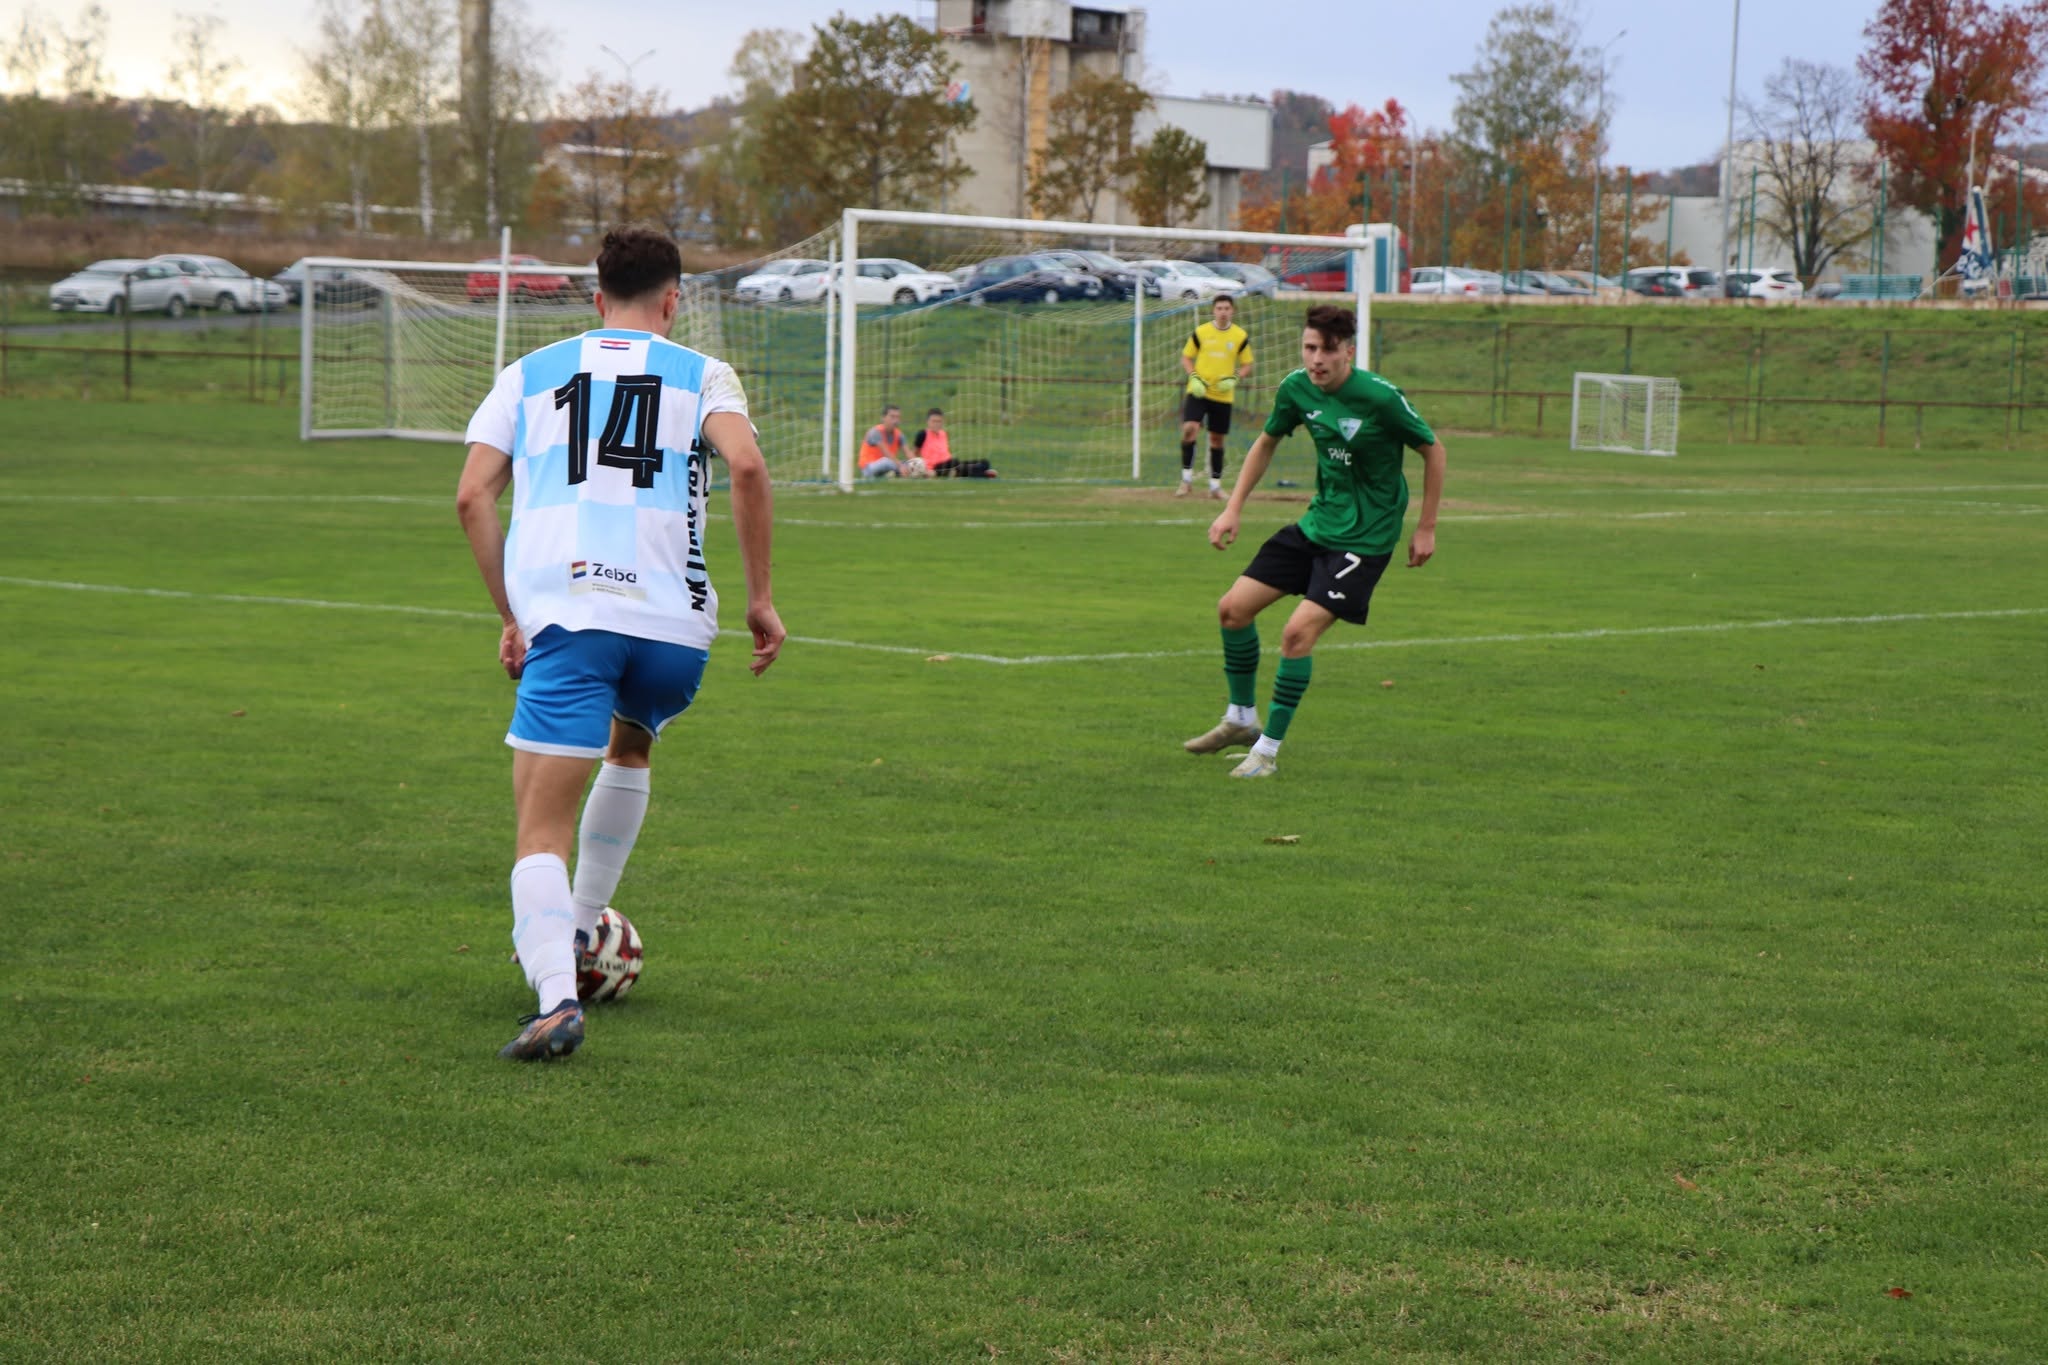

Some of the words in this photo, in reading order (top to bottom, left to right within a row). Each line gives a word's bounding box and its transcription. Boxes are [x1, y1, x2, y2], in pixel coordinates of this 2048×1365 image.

[554, 372, 664, 488] 14
[592, 562, 637, 583] Zeba
[1334, 551, 1361, 579] 7
